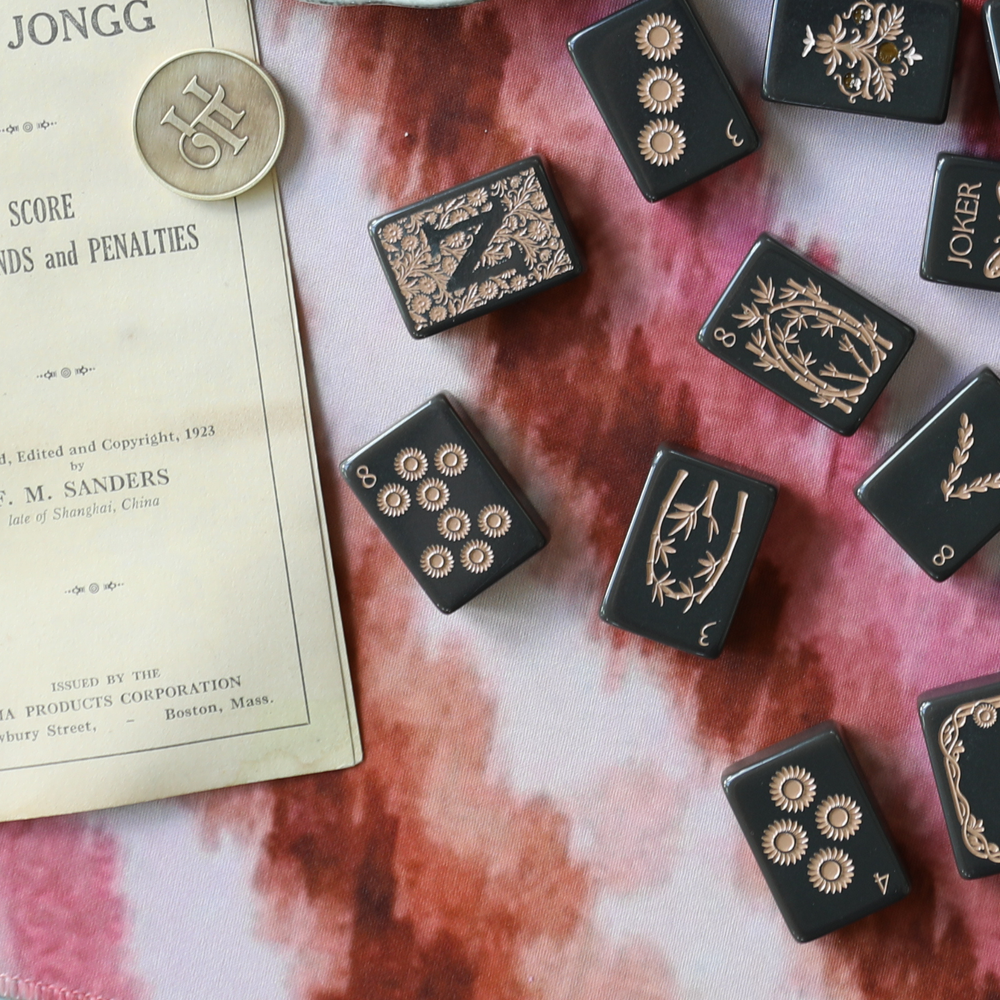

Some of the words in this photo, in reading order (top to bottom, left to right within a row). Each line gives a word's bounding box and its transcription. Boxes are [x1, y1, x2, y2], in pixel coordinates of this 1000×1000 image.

[7, 0, 156, 49] JONGG
[725, 118, 744, 148] 3
[8, 193, 75, 227] SCORE
[947, 181, 982, 269] JOKER
[45, 239, 79, 269] and
[88, 224, 200, 264] PENALTIES
[712, 326, 737, 348] 8
[17, 446, 64, 463] Edited
[69, 441, 97, 456] and
[102, 431, 180, 451] Copyright,
[185, 425, 216, 440] 1923
[70, 461, 85, 471] by
[355, 464, 377, 488] 8
[24, 485, 53, 503] M.
[64, 468, 170, 498] SANDERS
[8, 514, 31, 527] late
[36, 509, 48, 523] of
[53, 501, 117, 521] Shanghai,
[122, 495, 160, 511] China
[933, 543, 954, 566] 8
[26, 695, 113, 718] PRODUCTS
[121, 675, 242, 705] CORPORATION
[51, 676, 100, 693] ISSUED
[107, 673, 125, 685] BY
[132, 668, 161, 681] THE
[47, 721, 97, 738] Street,
[165, 702, 223, 721] Boston,
[231, 695, 274, 711] Mass.
[872, 870, 890, 895] 4
